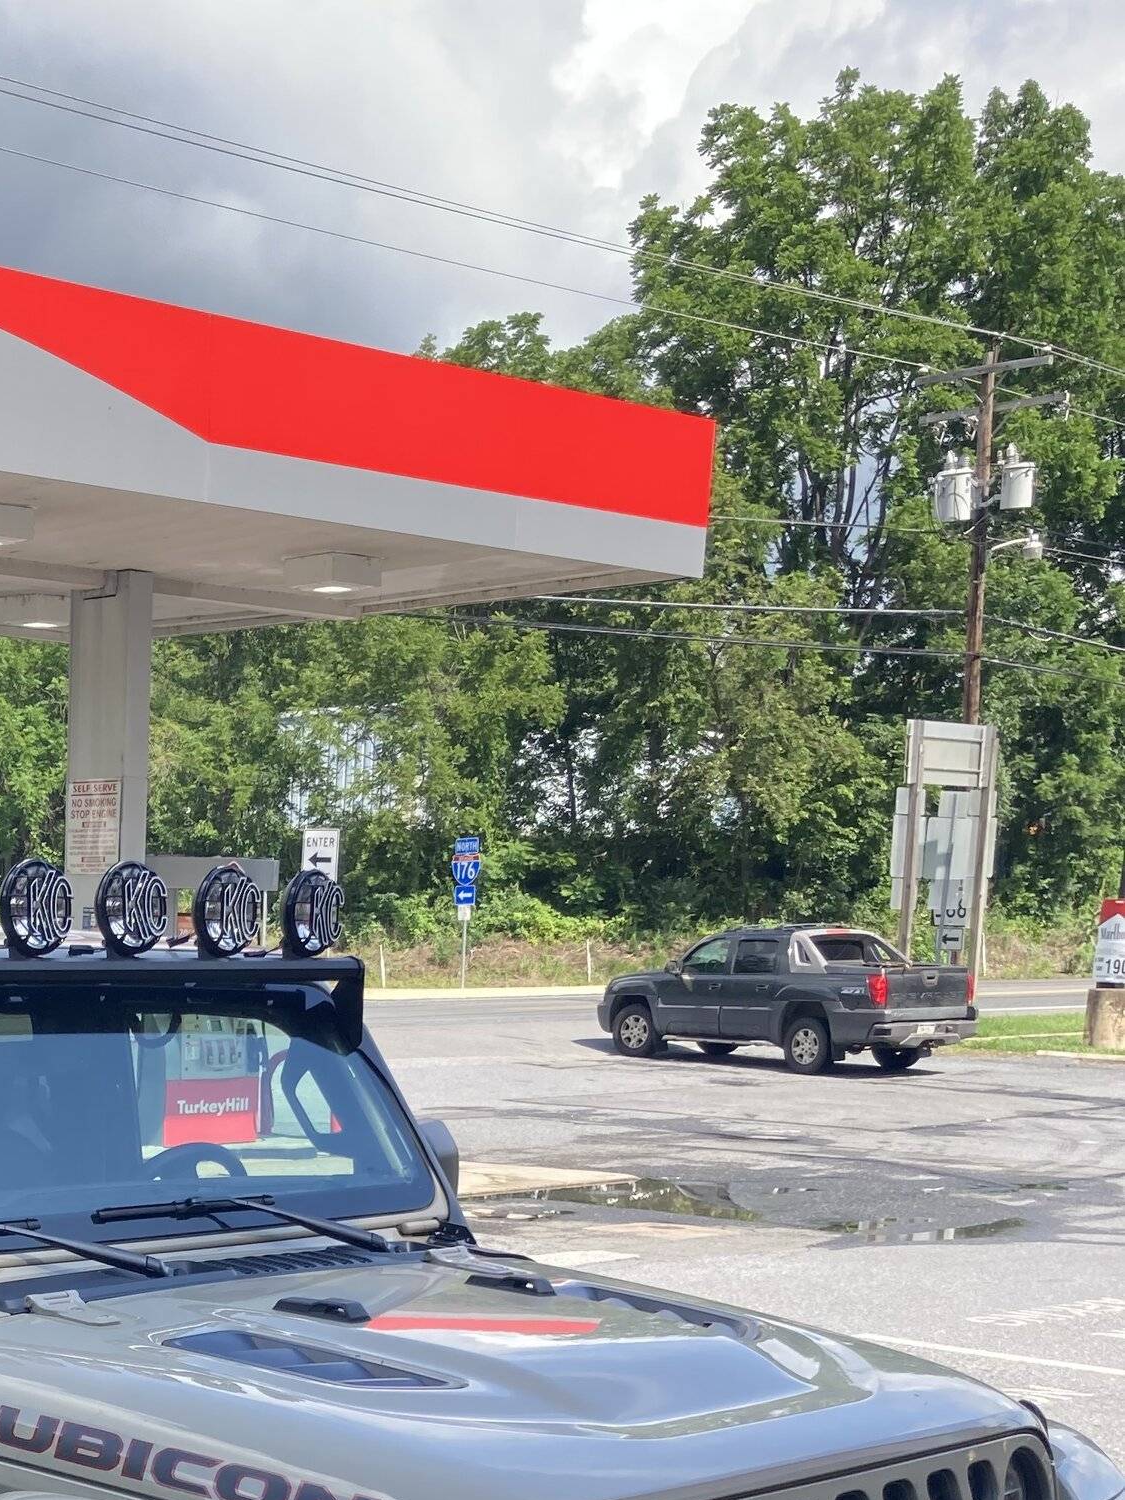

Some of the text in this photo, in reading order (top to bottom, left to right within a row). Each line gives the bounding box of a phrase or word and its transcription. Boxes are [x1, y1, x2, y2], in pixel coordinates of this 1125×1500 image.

[307, 837, 335, 848] ENTER
[457, 842, 477, 851] NORTH
[457, 862, 475, 880] 176
[30, 870, 74, 942] KC
[125, 871, 168, 940] KC
[223, 876, 263, 944] KC
[313, 880, 345, 945] KC
[177, 1097, 249, 1117] TurkeyHill
